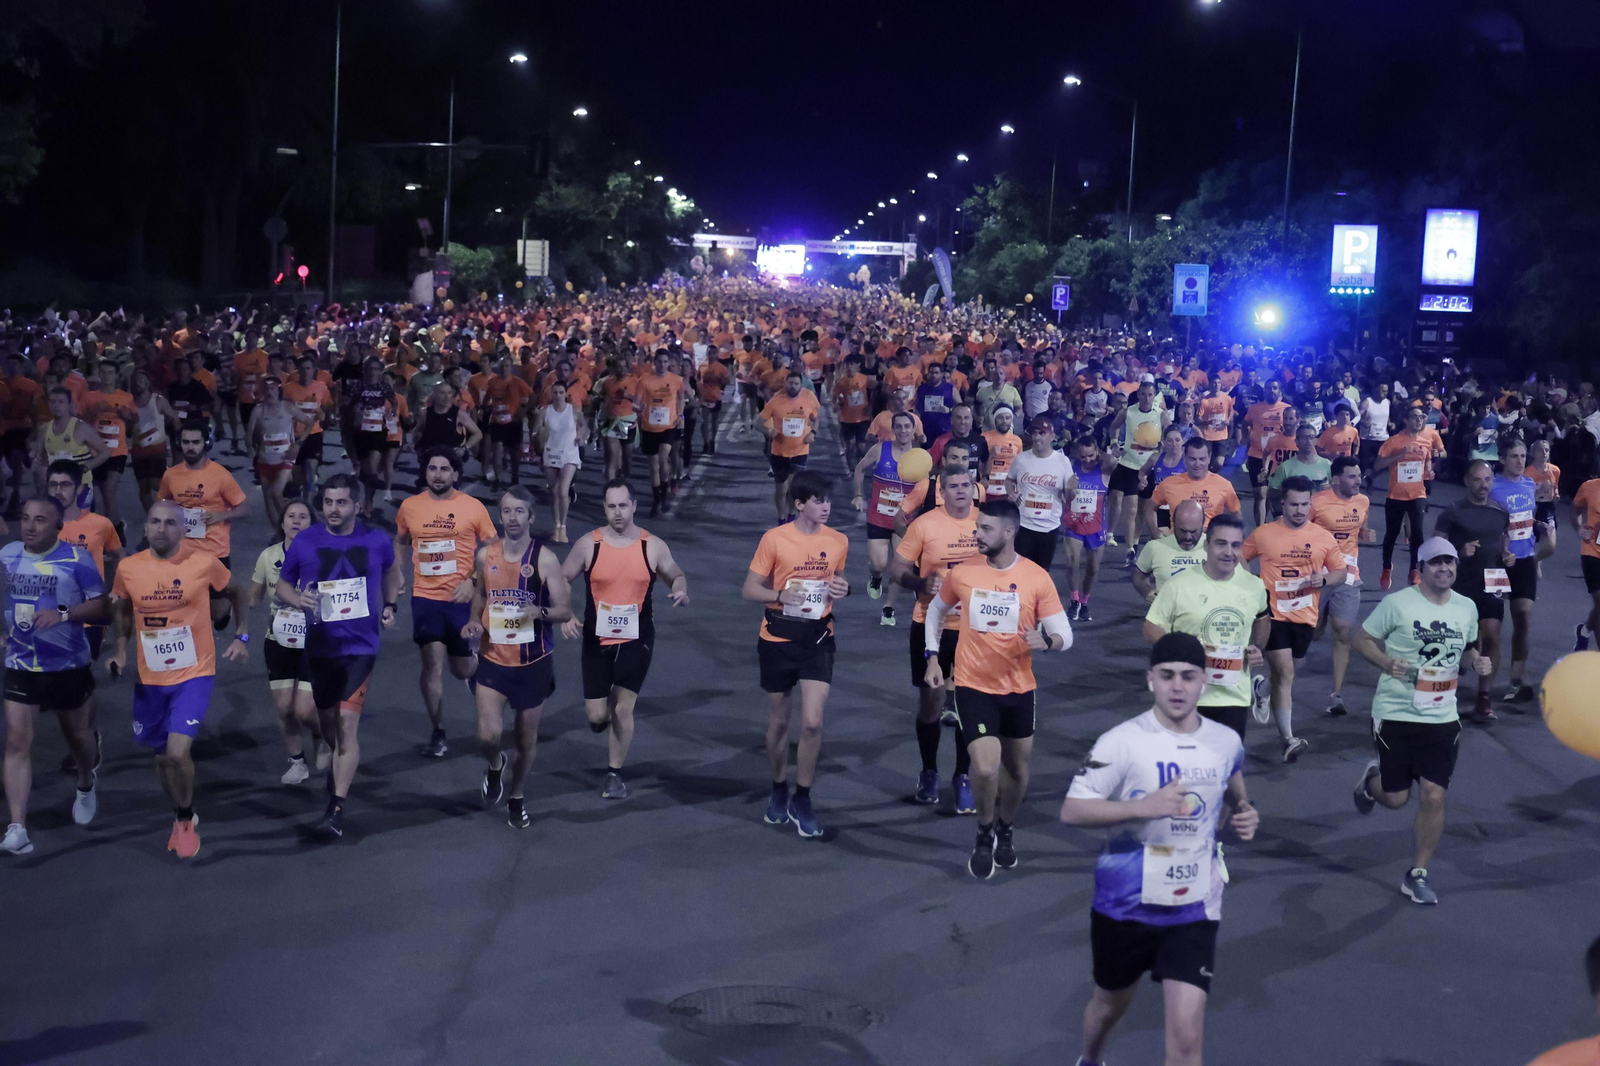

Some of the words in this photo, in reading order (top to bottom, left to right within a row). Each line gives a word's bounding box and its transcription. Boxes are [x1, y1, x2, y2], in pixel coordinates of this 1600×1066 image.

[1343, 230, 1369, 266] P
[1353, 257, 1367, 265] 24h
[1338, 275, 1363, 285] saba
[1056, 287, 1066, 299] P
[429, 552, 445, 562] 730
[330, 591, 360, 604] 17754
[488, 589, 537, 601] TLETISMO
[980, 603, 1010, 617] 20567
[503, 618, 521, 629] 295
[607, 615, 629, 626] 5578
[282, 622, 307, 635] 17030
[154, 641, 185, 655] 16510
[1420, 637, 1465, 669] 25
[1211, 658, 1233, 670] 1237
[1180, 766, 1218, 781] HUELVA
[1165, 863, 1199, 880] 4530
